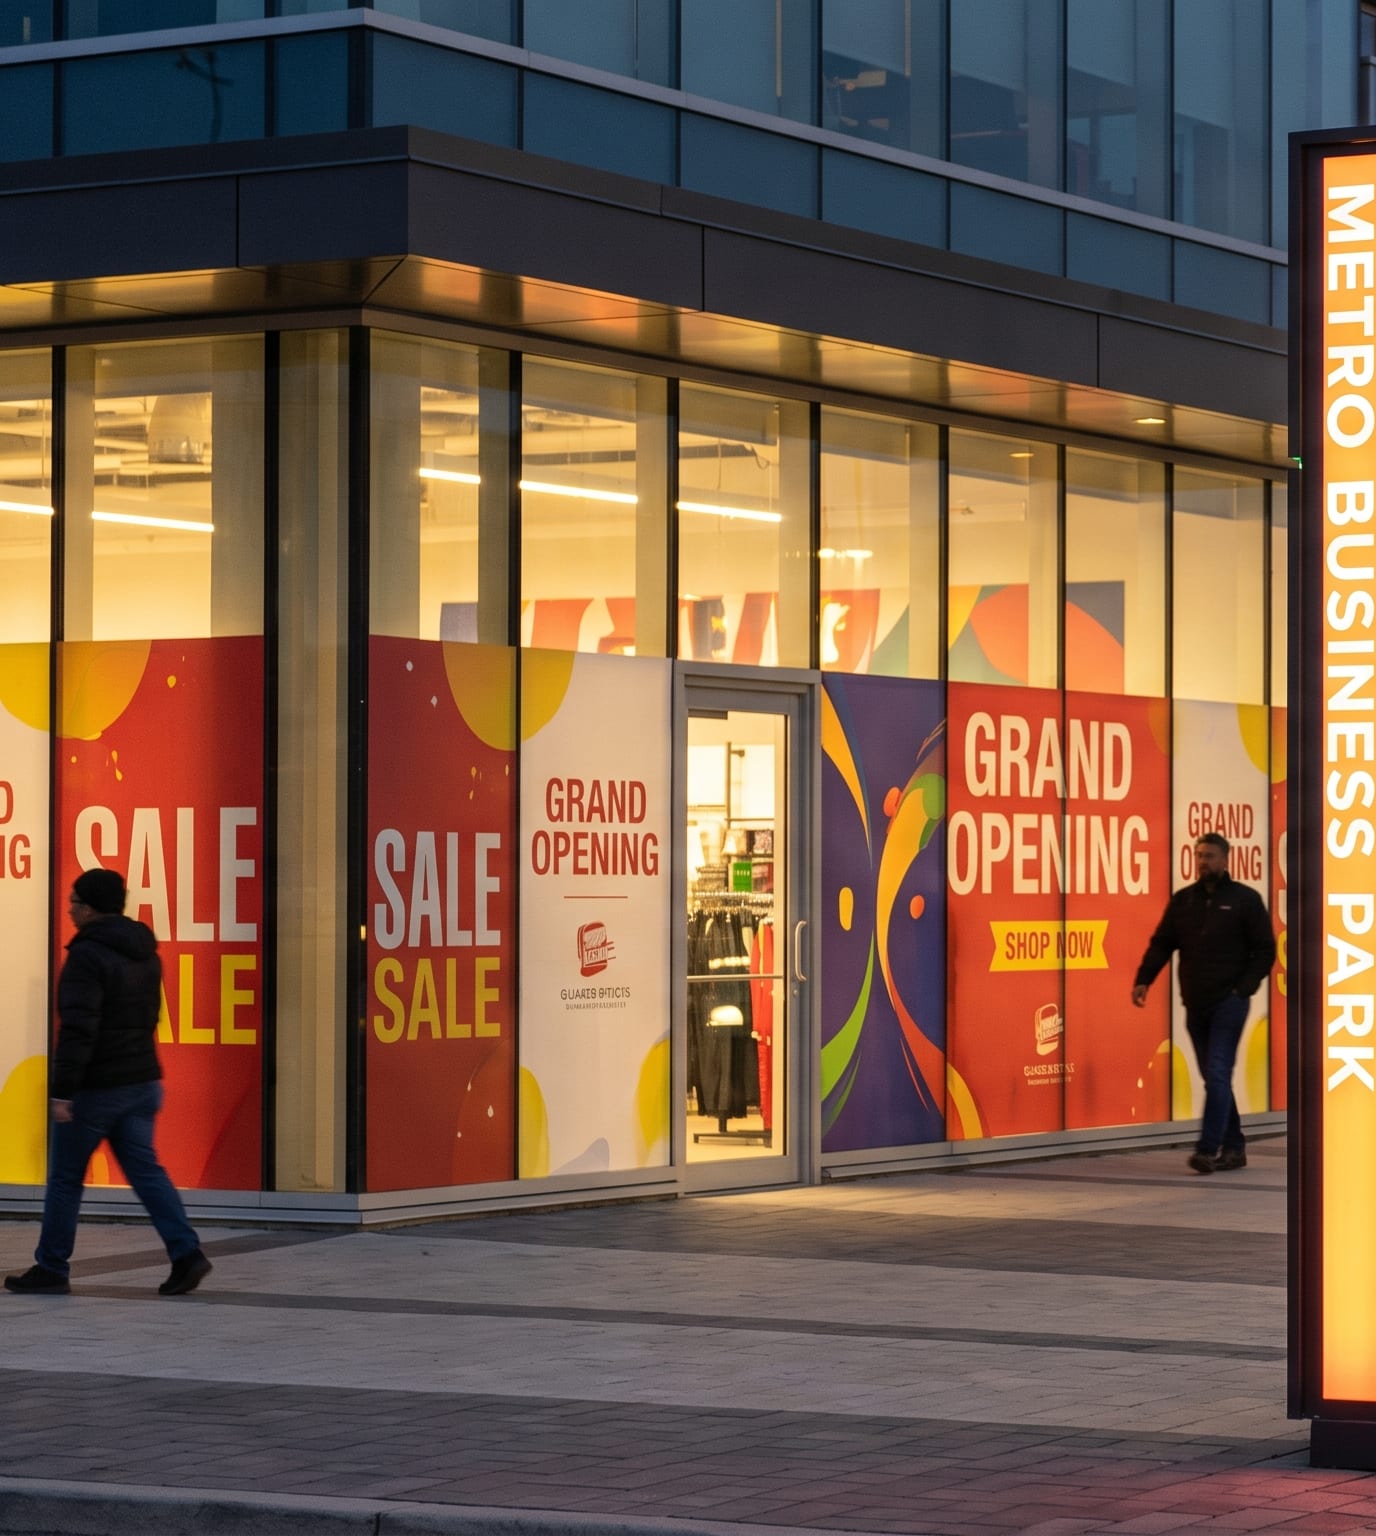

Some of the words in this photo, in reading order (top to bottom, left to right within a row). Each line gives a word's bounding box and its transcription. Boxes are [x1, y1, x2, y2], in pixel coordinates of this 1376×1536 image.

[1326, 183, 1375, 449] METRO
[1326, 480, 1375, 860] BUSINESS
[965, 711, 1132, 801] GRAND
[545, 777, 647, 824] GRAND
[1187, 800, 1254, 840] GRAND
[373, 827, 501, 949] SALE
[531, 829, 660, 878] OPENING
[947, 811, 1150, 896] OPENING
[1005, 931, 1050, 961] SHOP
[1056, 930, 1094, 960] NOW
[373, 957, 501, 1043] SALE
[1326, 892, 1375, 1092] PARK
